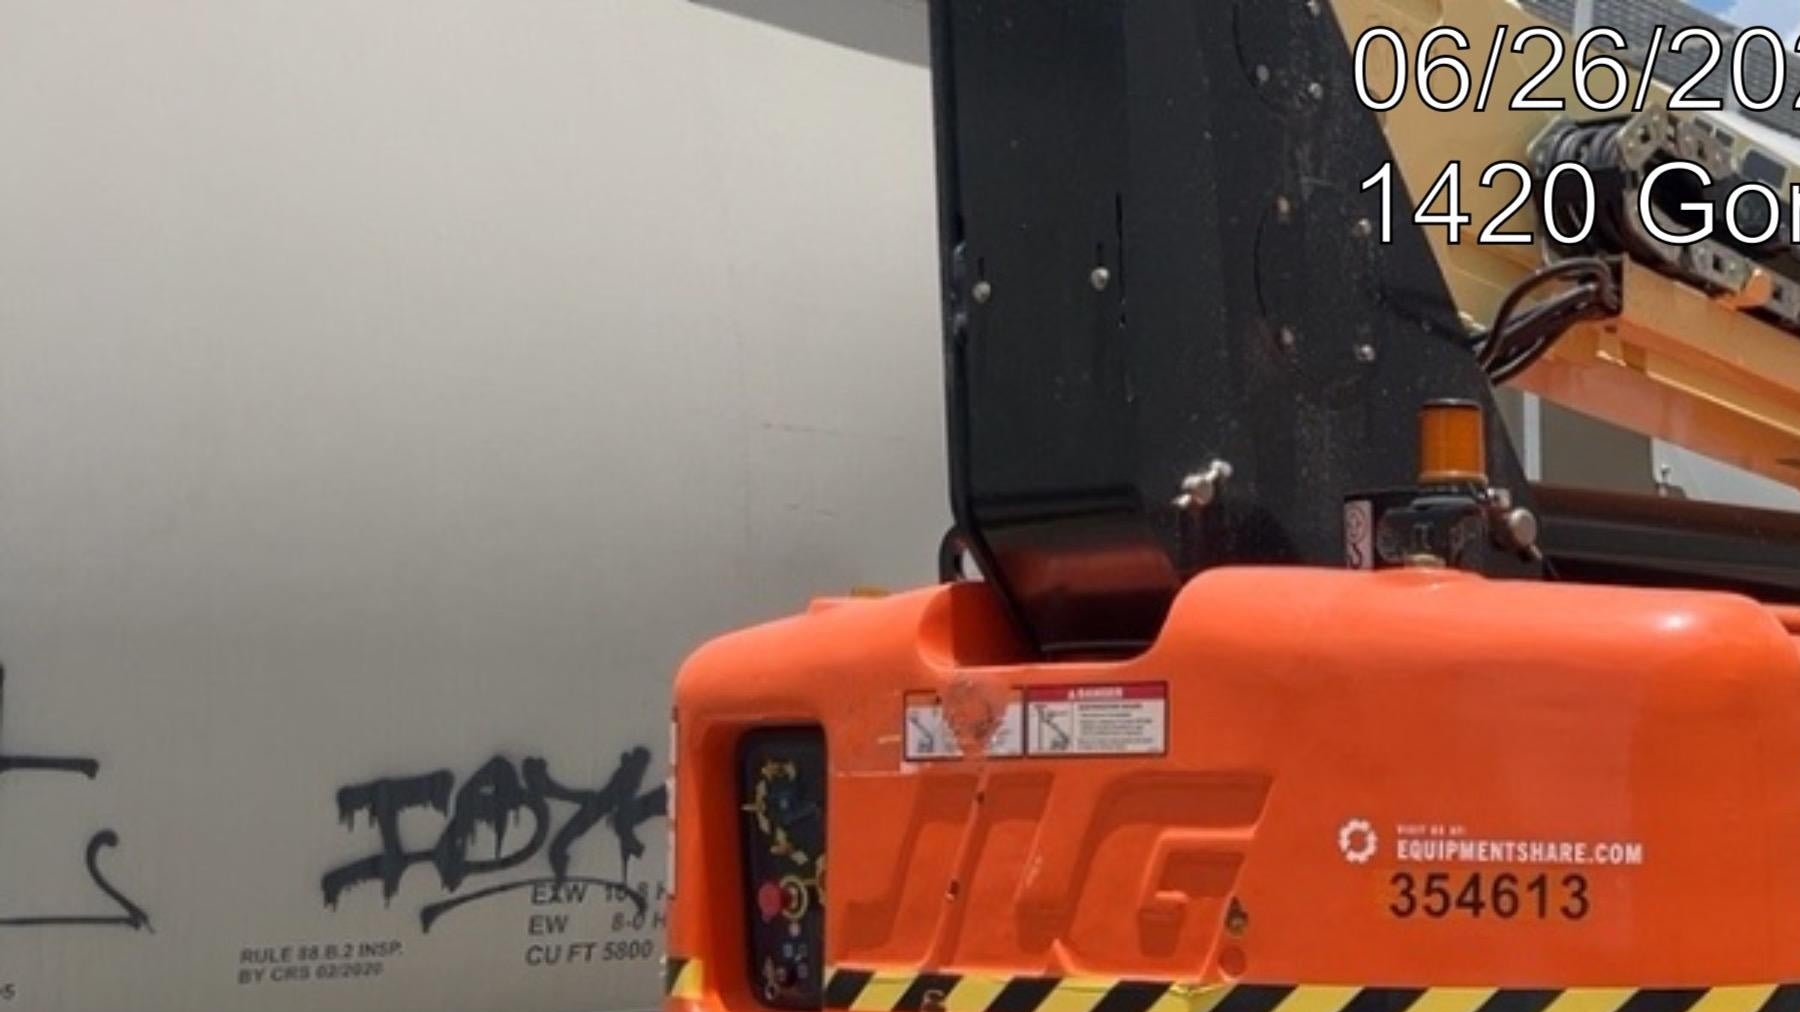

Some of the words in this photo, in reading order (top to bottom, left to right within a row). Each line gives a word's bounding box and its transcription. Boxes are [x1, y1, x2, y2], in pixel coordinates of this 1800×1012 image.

[1397, 839, 1643, 865] EQUIPMENTSHARE.COM
[1389, 872, 1590, 920] 354613
[528, 914, 569, 936] EW
[239, 946, 291, 964] RULE
[525, 944, 561, 966] CU
[567, 942, 598, 963] FT
[602, 939, 655, 961] 5800
[238, 967, 265, 985] BY
